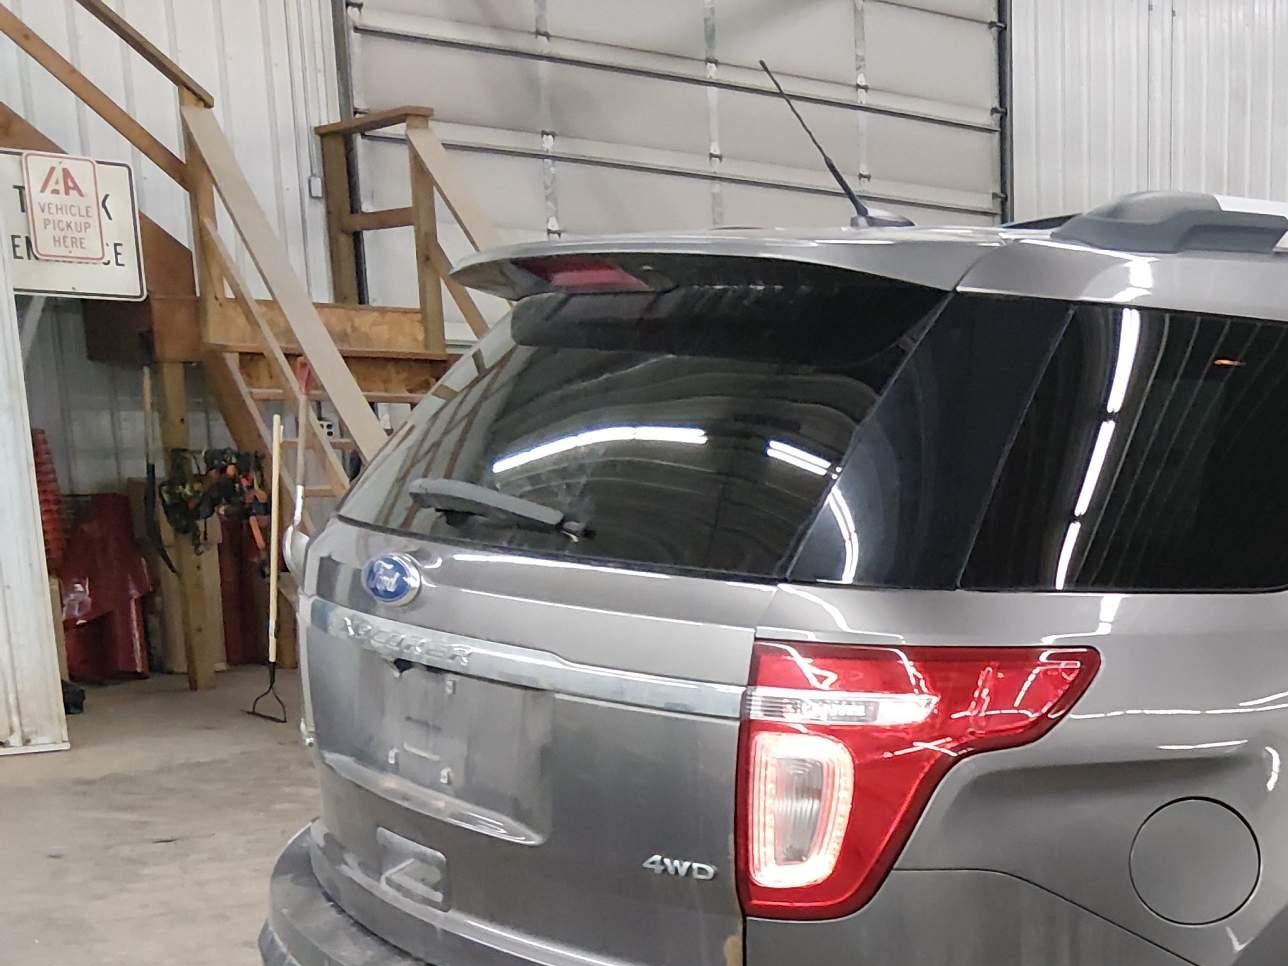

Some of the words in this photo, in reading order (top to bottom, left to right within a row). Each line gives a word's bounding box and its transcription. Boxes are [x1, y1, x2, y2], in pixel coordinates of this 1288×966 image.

[38, 202, 93, 218] VEHICLE
[43, 218, 91, 233] PICKUP
[53, 235, 88, 249] HERE
[642, 854, 715, 880] 4WD
